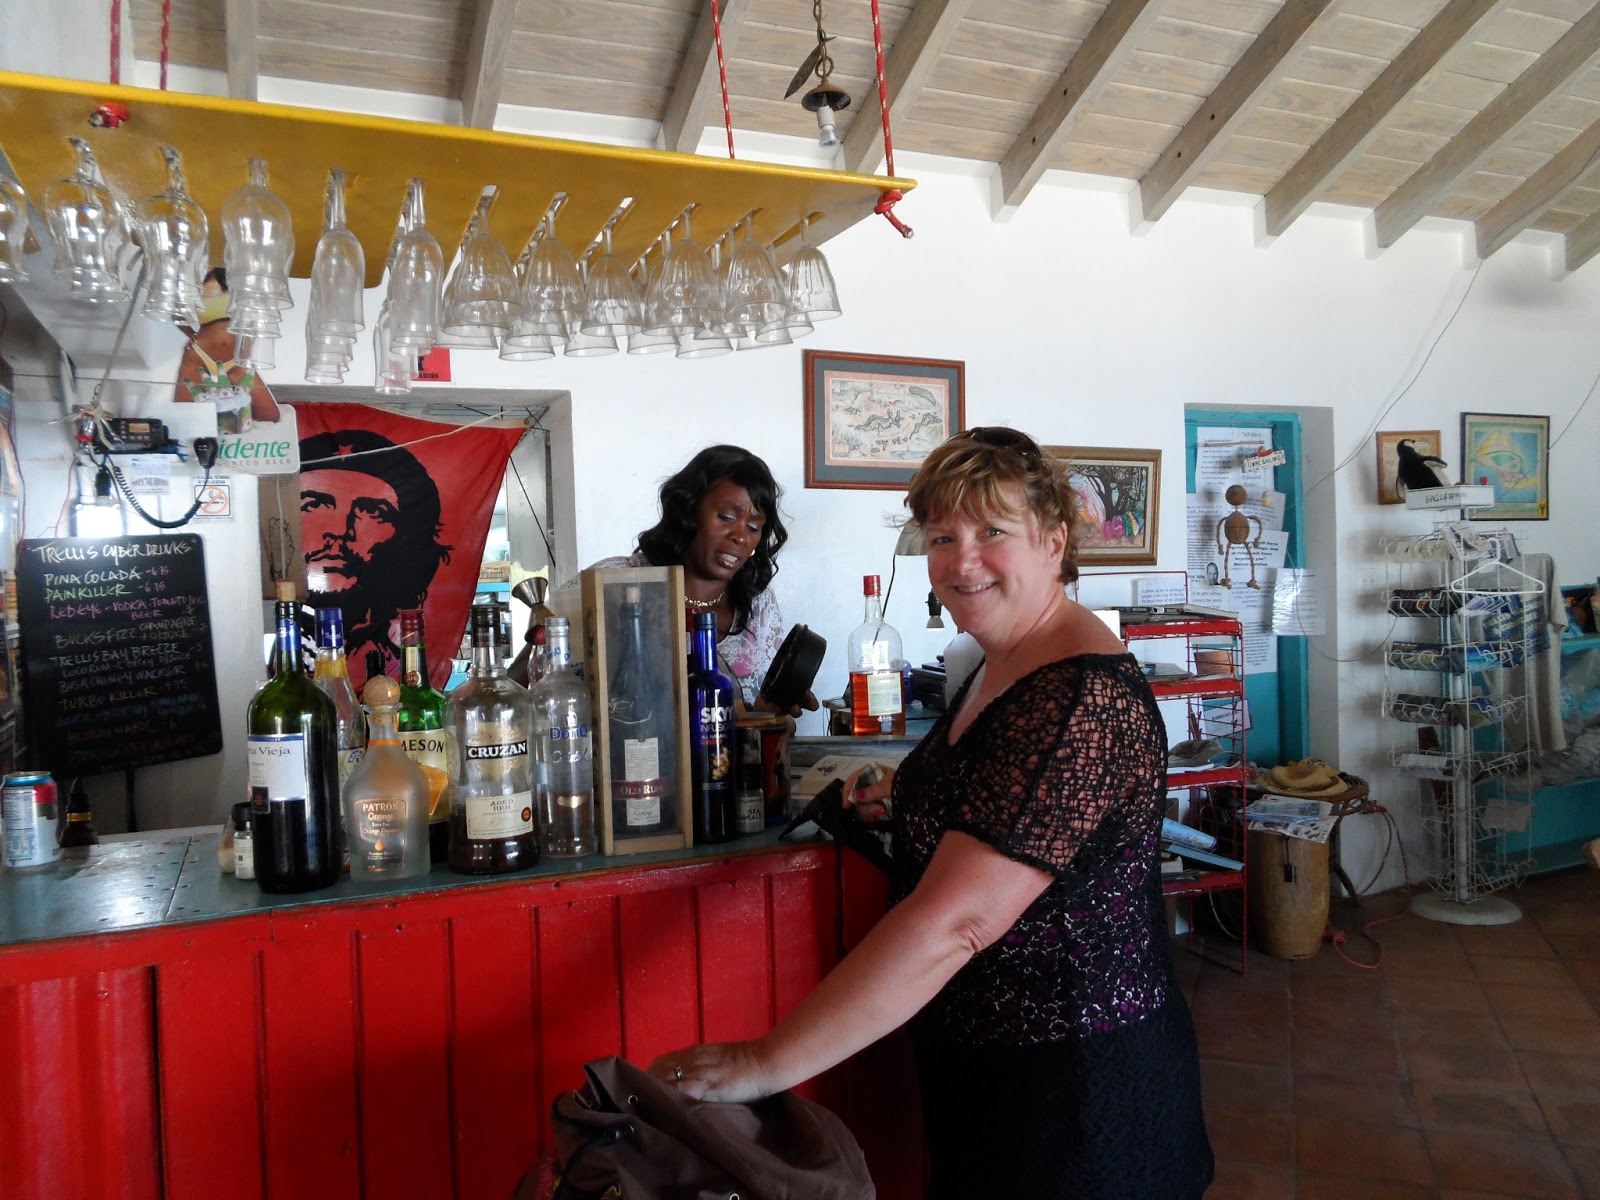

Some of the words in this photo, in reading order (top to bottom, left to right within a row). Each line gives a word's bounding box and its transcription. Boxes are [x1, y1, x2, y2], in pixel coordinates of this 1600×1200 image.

[218, 438, 292, 460] idente
[145, 541, 193, 557] DRINKS
[44, 573, 82, 587] PINA
[84, 566, 144, 585] COLADA
[44, 583, 133, 603] PAINKILLER
[700, 705, 734, 724] SKYY
[258, 746, 291, 758] Vieja
[401, 738, 445, 754] MESON
[467, 742, 527, 758] CRUZAN
[620, 785, 641, 796] OLD
[643, 784, 665, 795] RUM
[489, 798, 514, 807] AGED
[492, 804, 511, 812] RUM
